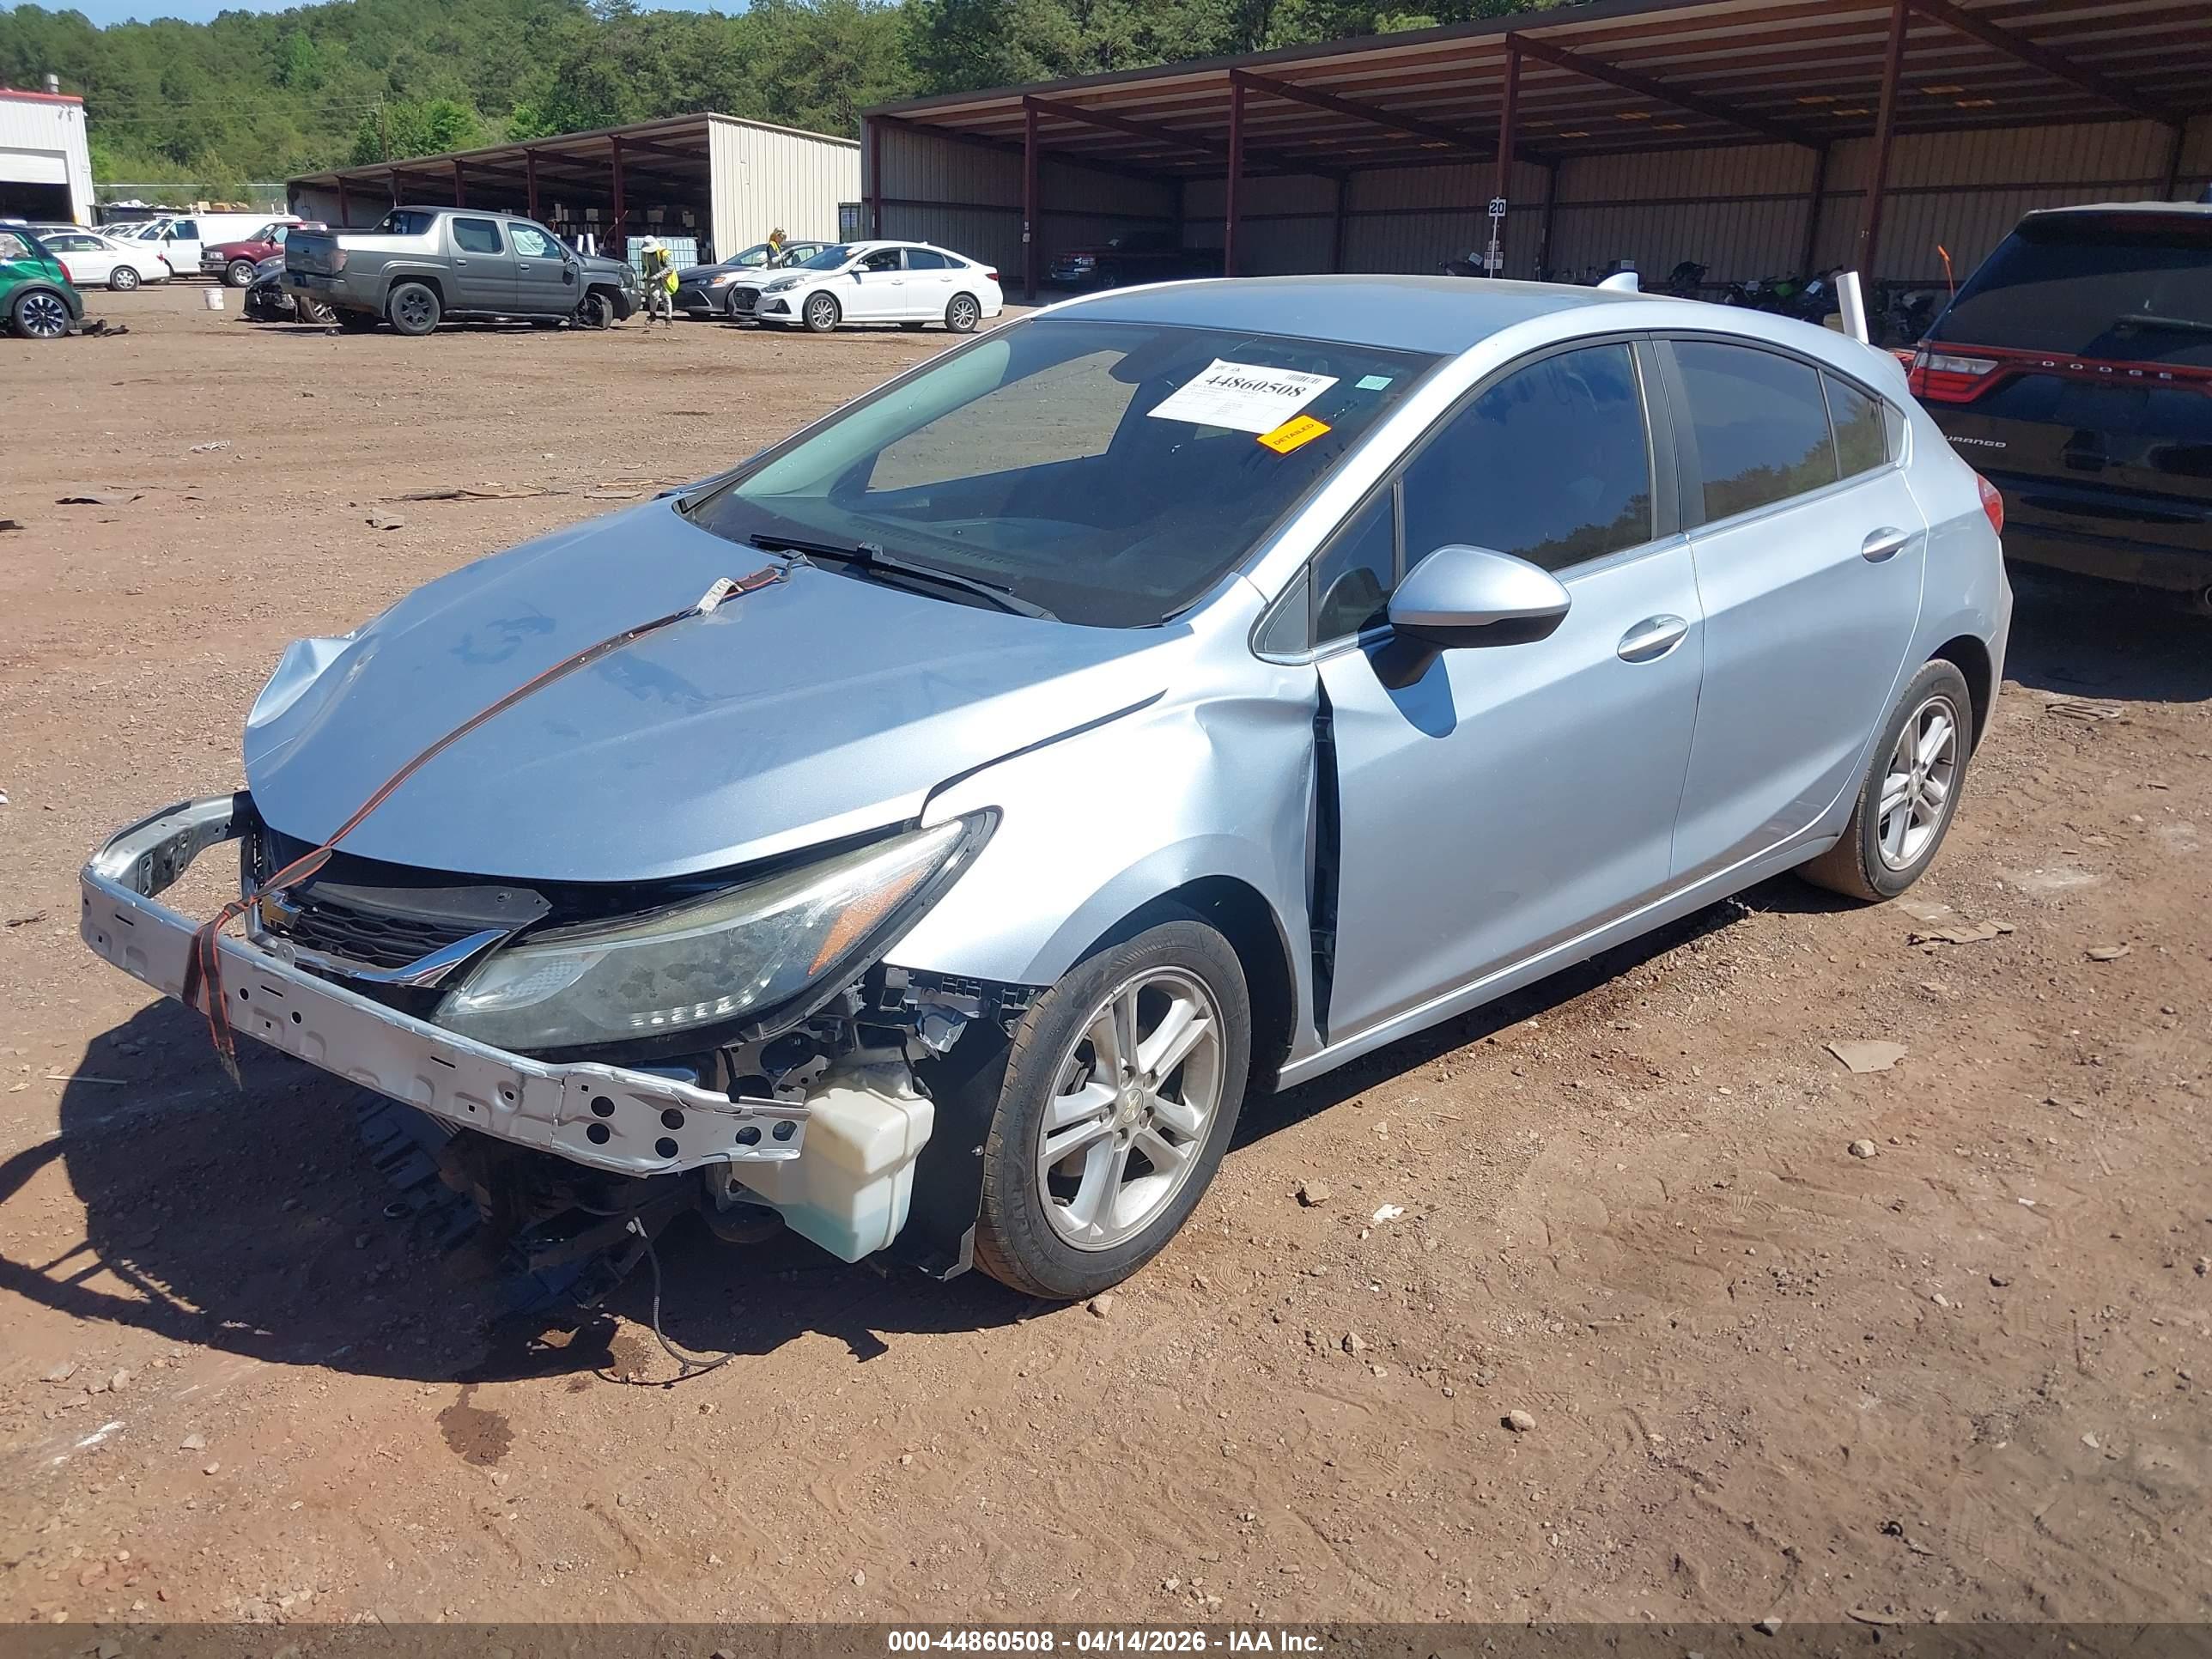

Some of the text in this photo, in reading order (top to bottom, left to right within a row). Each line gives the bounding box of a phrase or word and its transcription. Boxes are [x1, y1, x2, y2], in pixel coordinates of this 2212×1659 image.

[1490, 202, 1505, 214] 20
[2042, 361, 2172, 380] DODGE
[1205, 375, 1307, 398] 44860508
[1273, 423, 1315, 446] DETAILED
[1944, 435, 2007, 448] URANGO
